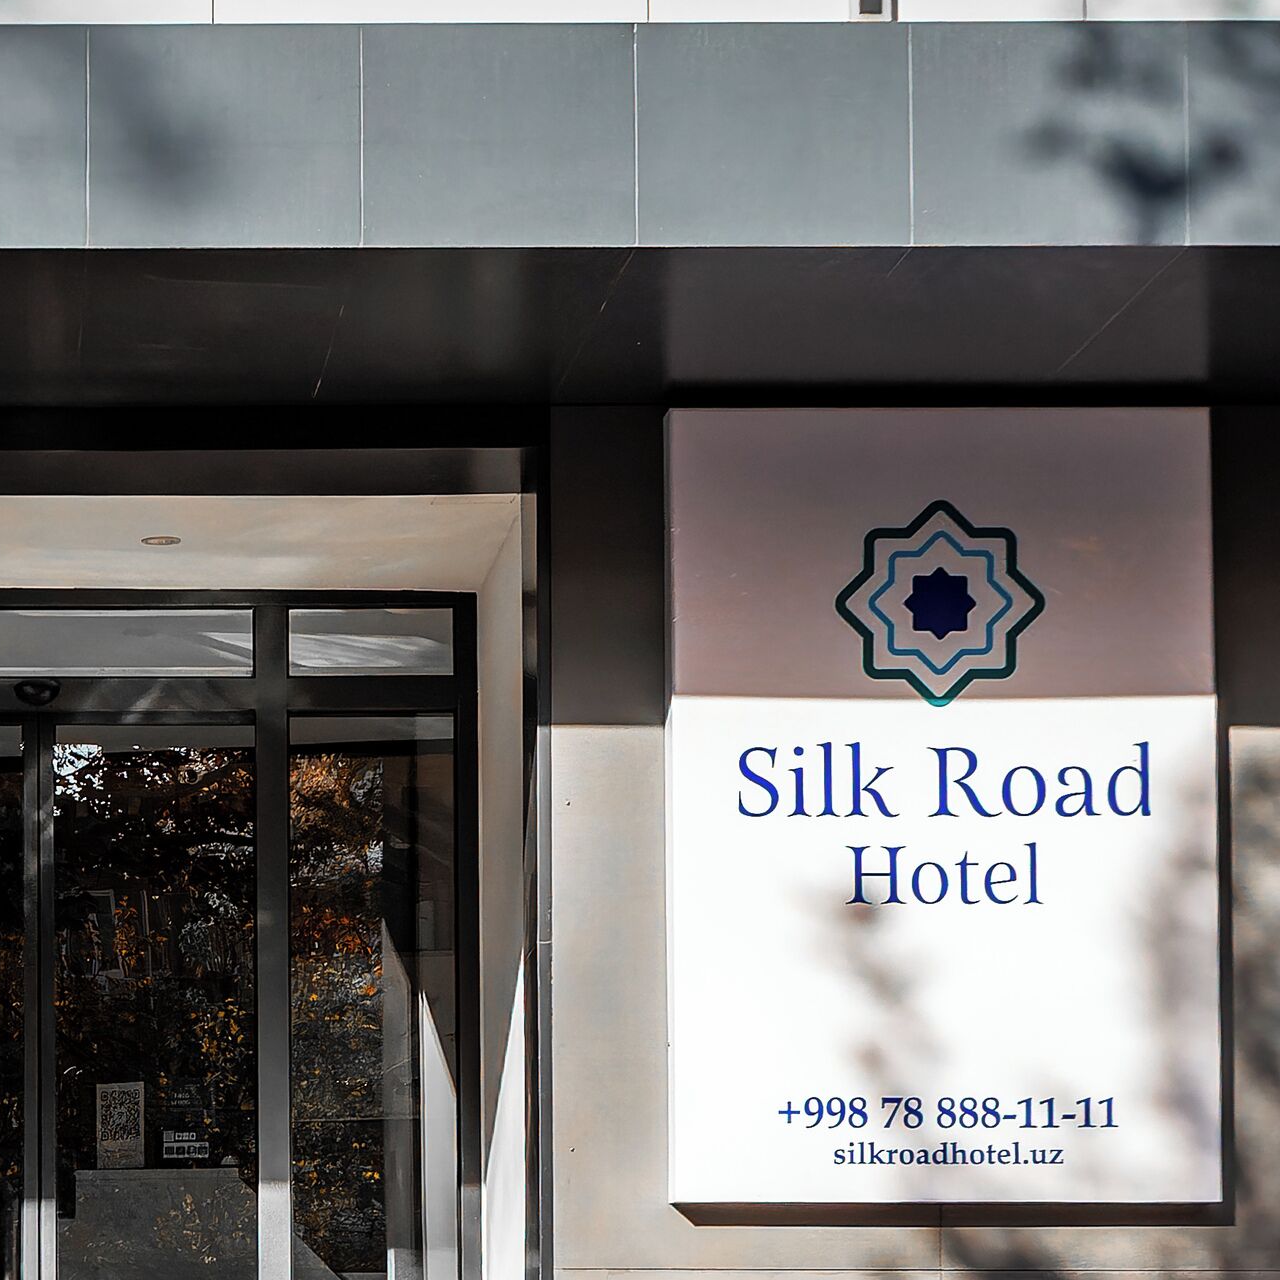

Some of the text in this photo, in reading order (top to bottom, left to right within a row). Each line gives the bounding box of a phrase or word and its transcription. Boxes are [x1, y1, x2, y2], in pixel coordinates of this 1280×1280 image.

[738, 741, 1152, 818] Silk Road
[844, 841, 1044, 905] Hotel
[778, 1096, 1119, 1129] +998 78 888-11-11
[833, 1141, 1064, 1165] silkroadhotel.uz
